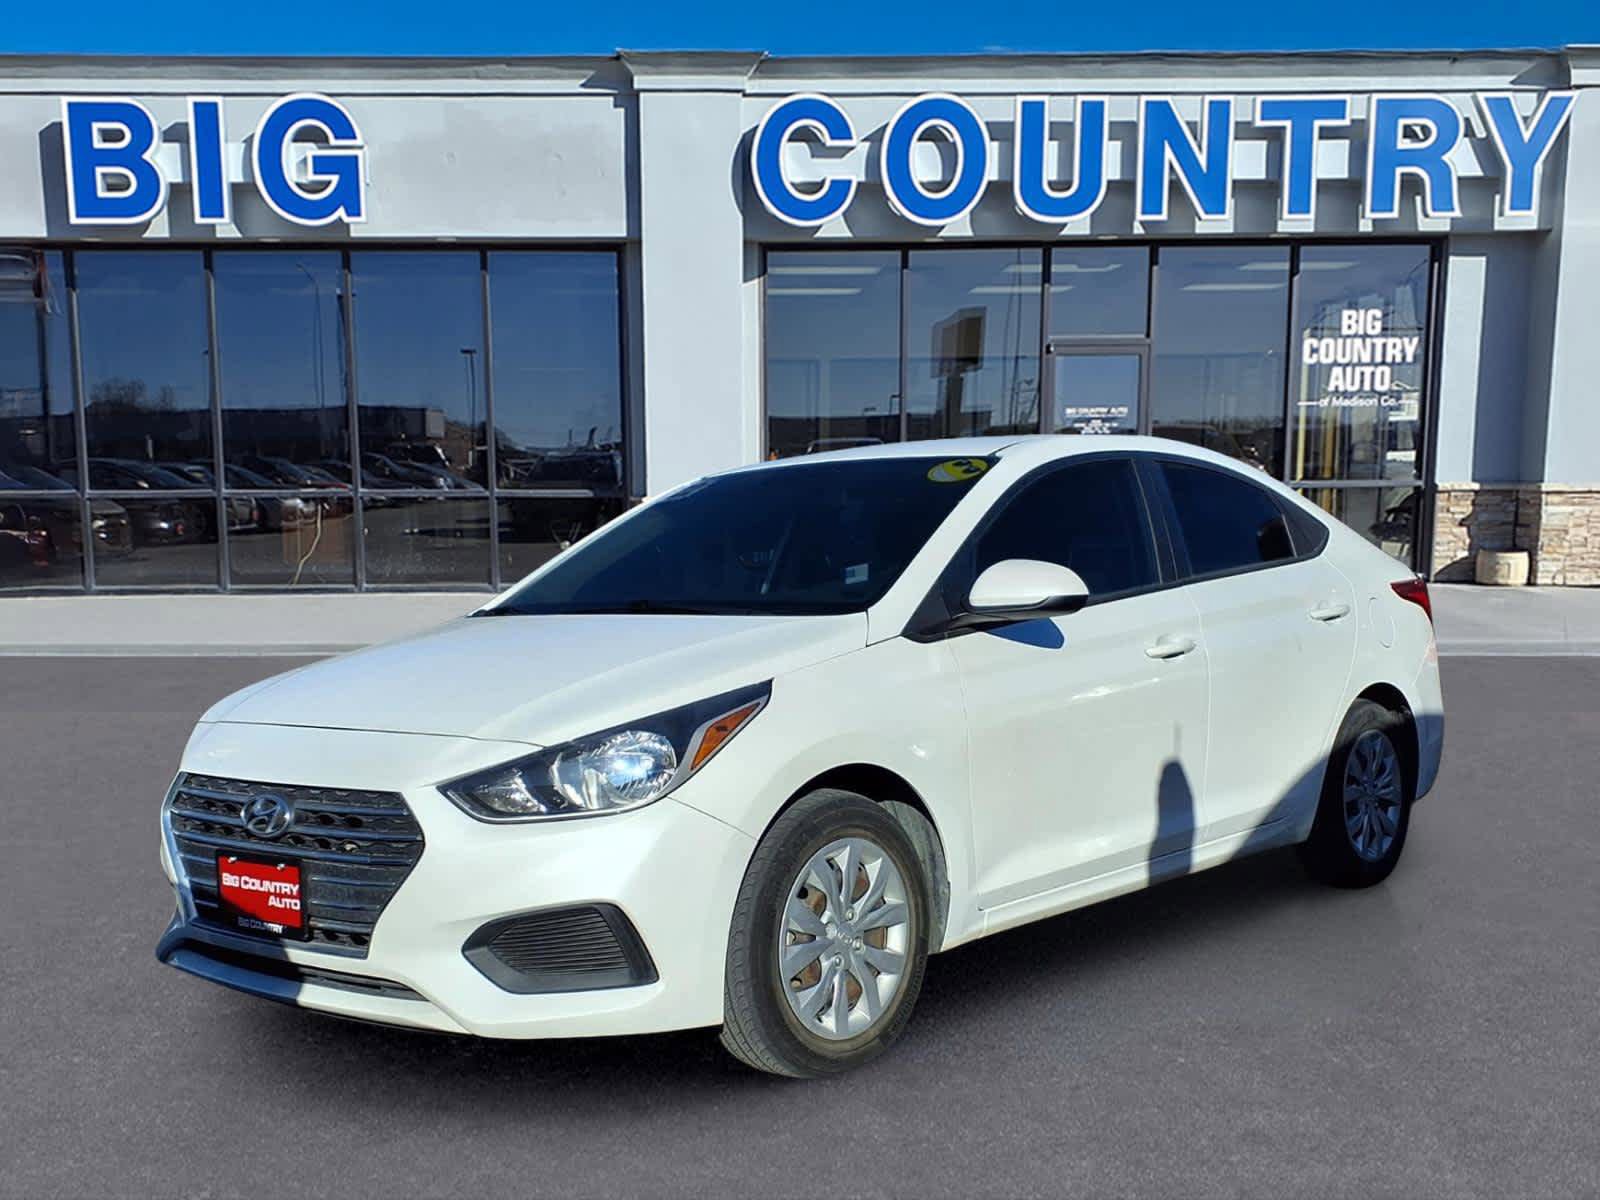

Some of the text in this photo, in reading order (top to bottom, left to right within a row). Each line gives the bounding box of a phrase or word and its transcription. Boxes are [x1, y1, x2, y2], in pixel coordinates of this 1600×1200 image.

[61, 91, 1577, 227] BIG COUNTRY
[1341, 309, 1382, 336] BIG
[1303, 337, 1419, 364] COUNTRY
[1328, 366, 1391, 391] AUTO
[1331, 397, 1378, 407] Madison
[222, 873, 299, 895] BIG COUNTRY
[267, 895, 300, 910] AUTO
